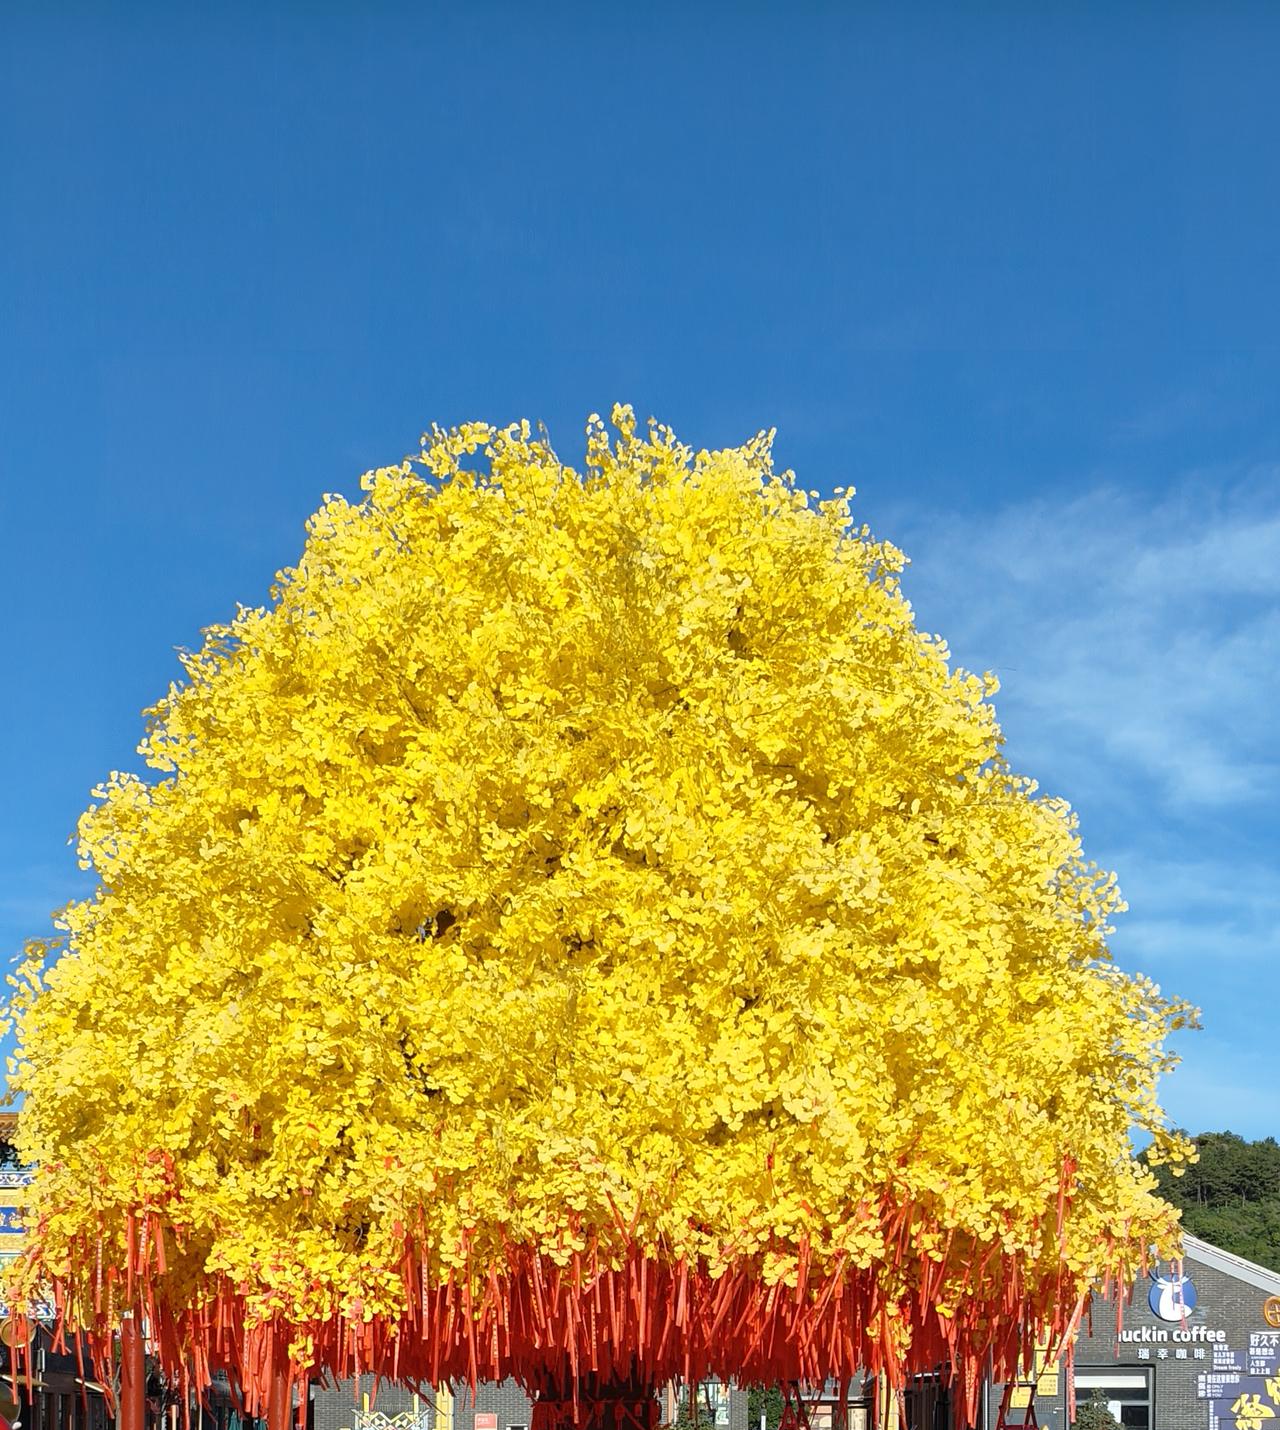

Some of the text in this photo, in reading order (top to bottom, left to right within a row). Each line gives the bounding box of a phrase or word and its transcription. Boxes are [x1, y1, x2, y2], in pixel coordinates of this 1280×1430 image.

[1172, 1326, 1226, 1343] coffee
[1250, 1334, 1279, 1347] 好久不
[1138, 1348, 1206, 1360] 瑞幸咖啡
